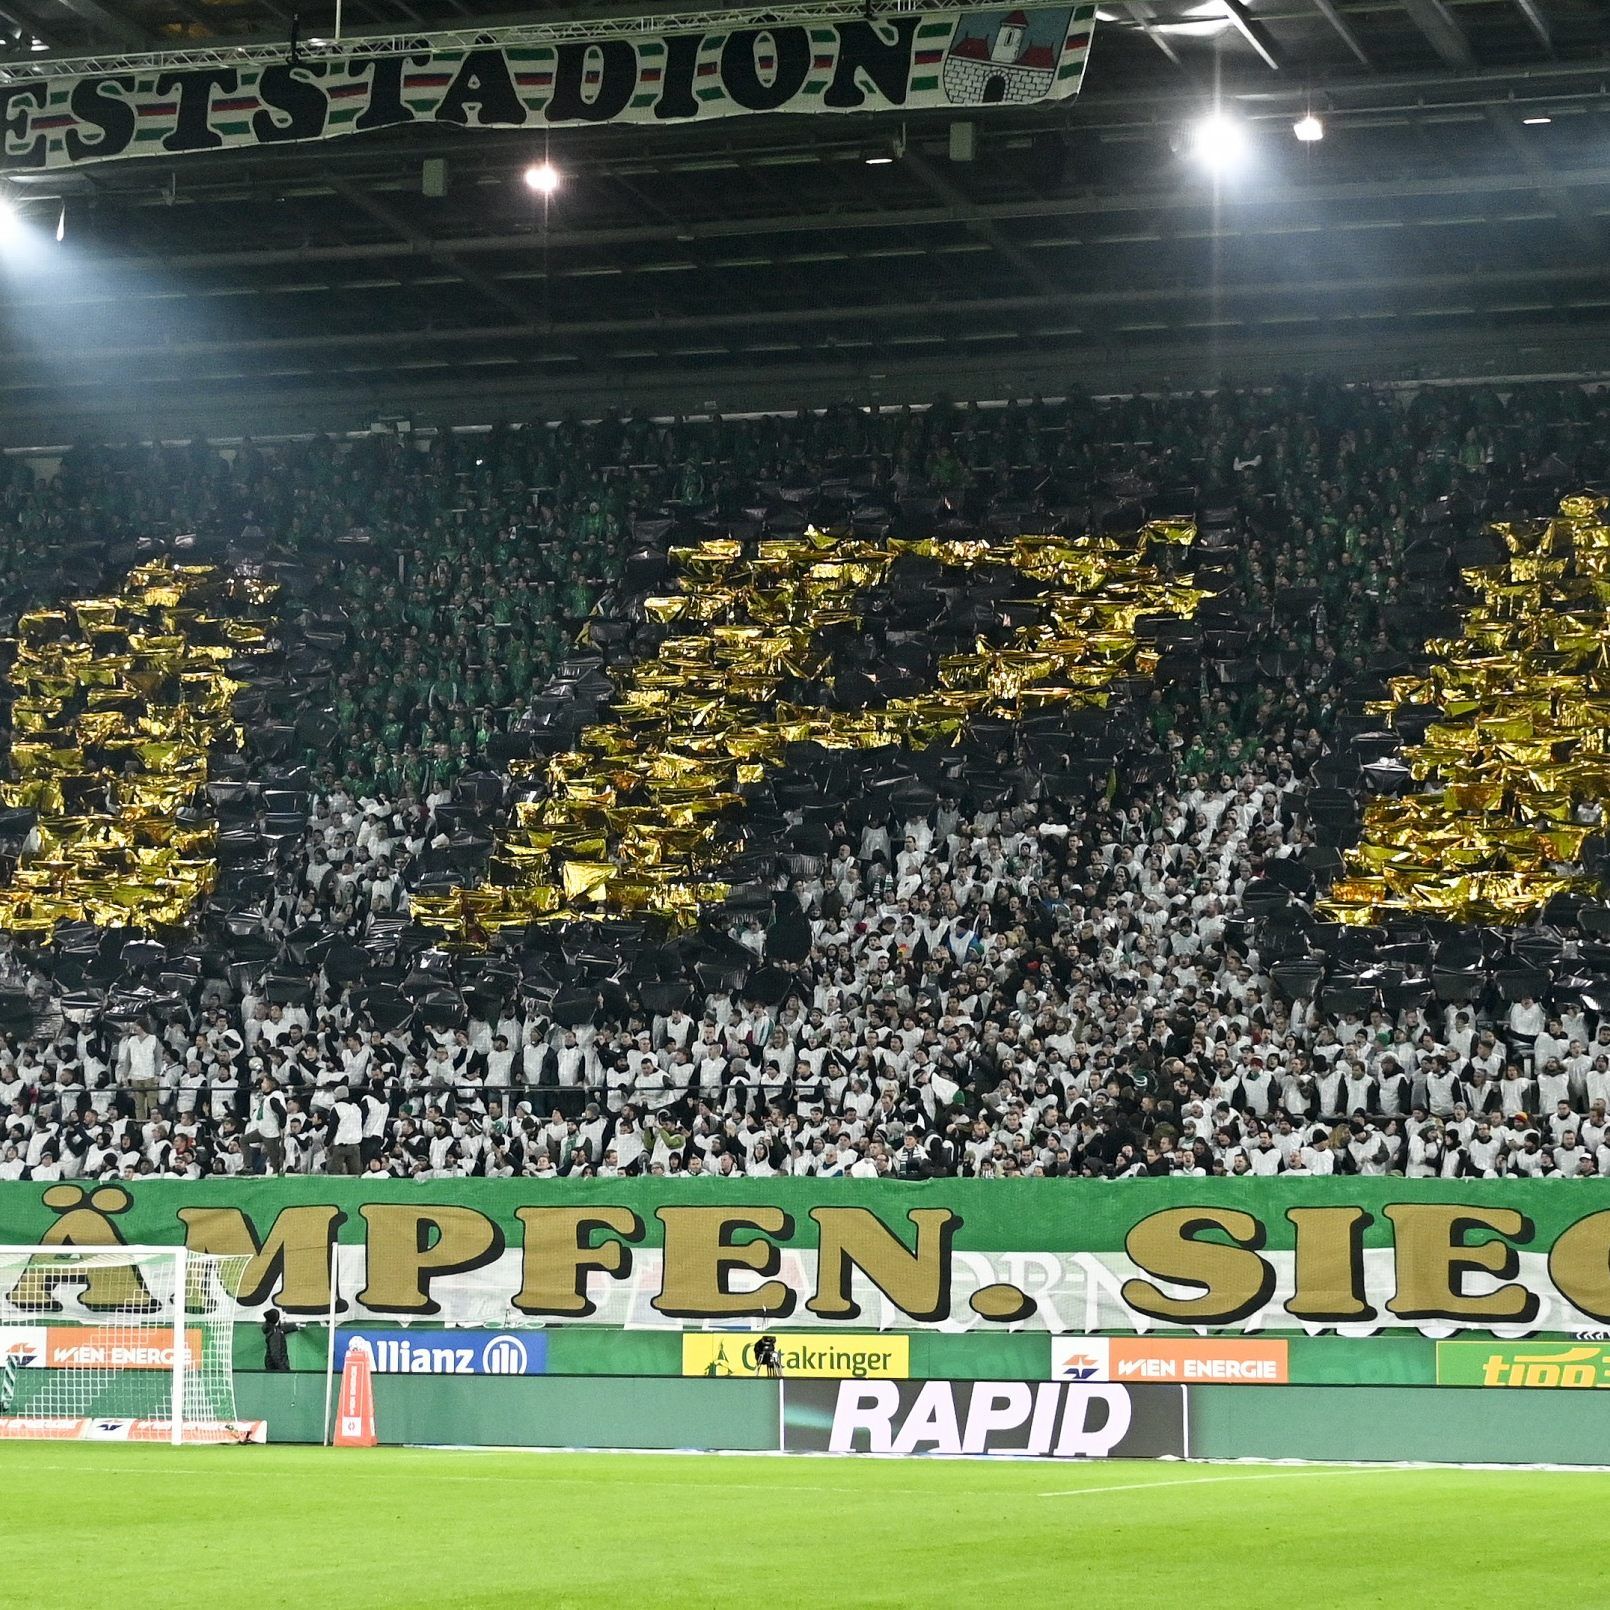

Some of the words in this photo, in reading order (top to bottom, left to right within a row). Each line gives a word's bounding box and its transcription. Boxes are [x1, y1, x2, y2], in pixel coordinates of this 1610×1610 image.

[54, 1346, 104, 1364] WIEN
[1118, 1359, 1176, 1378] WIEN
[1183, 1360, 1278, 1379] ENERGIE
[829, 1380, 1132, 1457] RAPID
